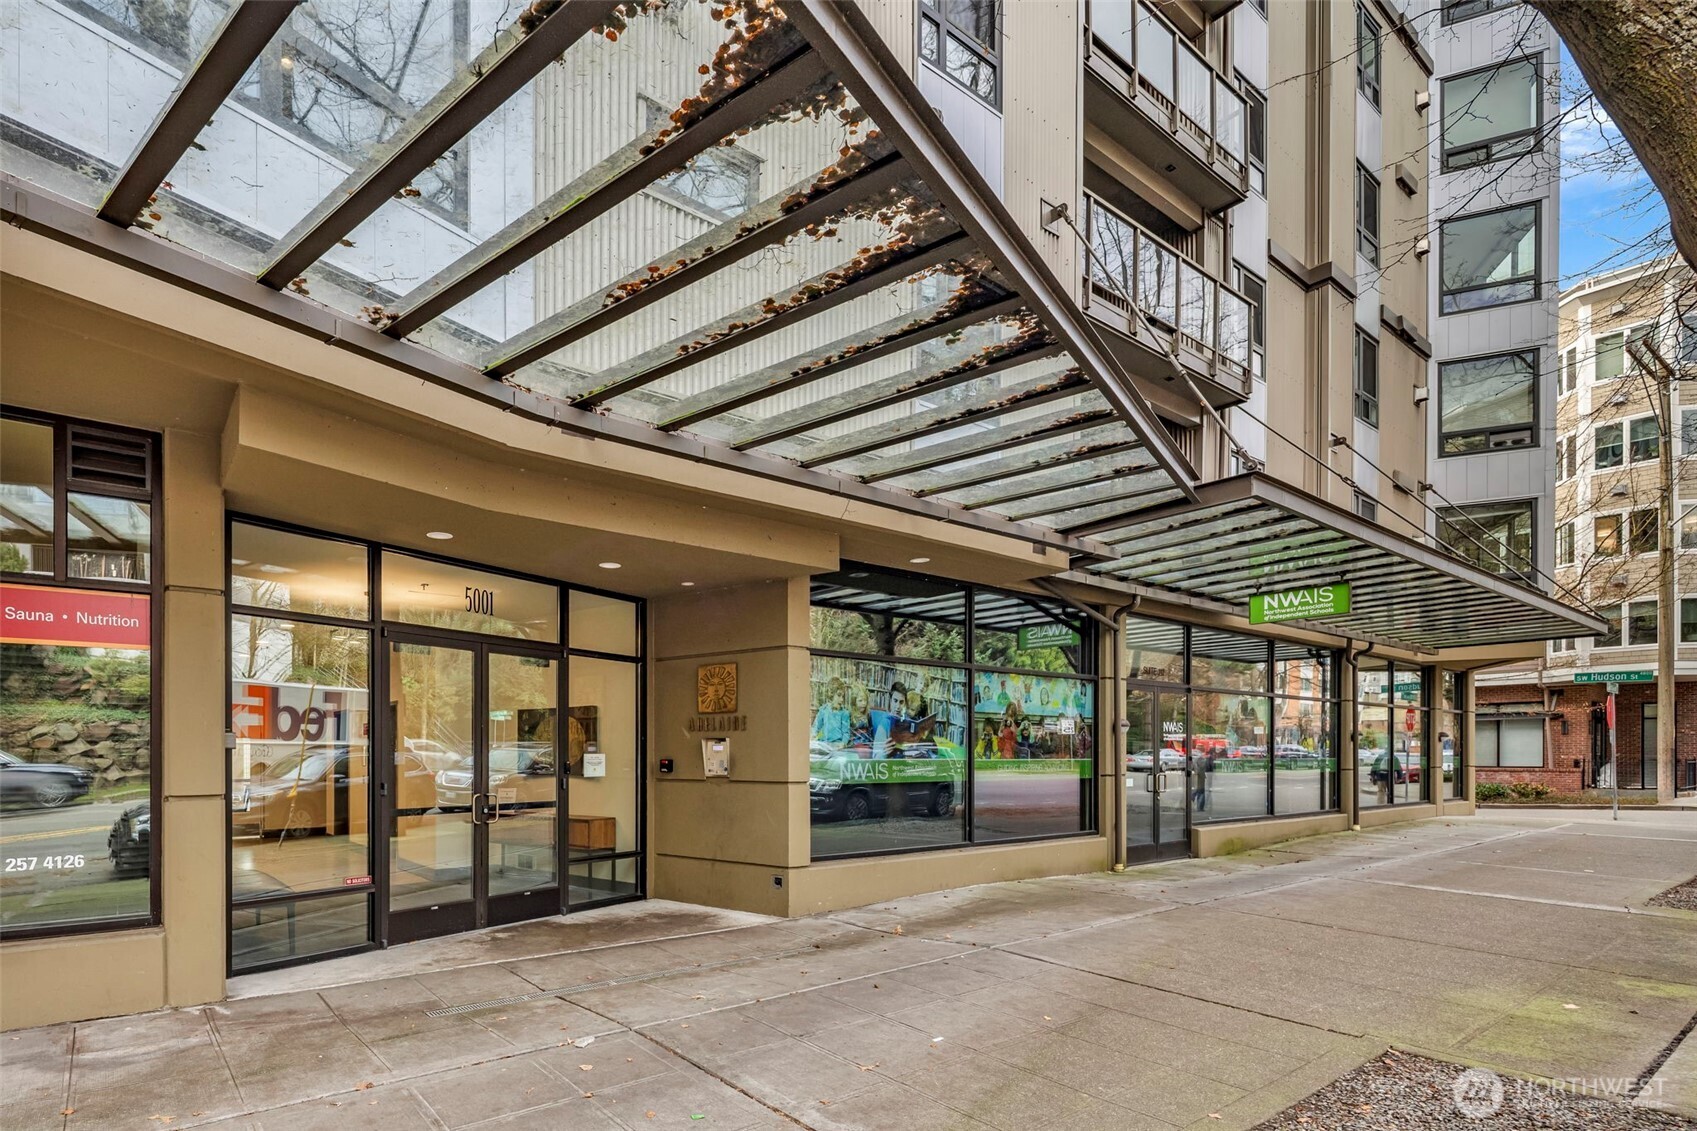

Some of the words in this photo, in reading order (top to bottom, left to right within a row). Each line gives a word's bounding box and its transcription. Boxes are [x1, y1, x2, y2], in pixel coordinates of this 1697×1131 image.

[465, 586, 494, 617] 5001
[1263, 586, 1334, 610] NWAIS
[4, 606, 54, 622] Sauna
[76, 611, 140, 628] Nutrition
[1263, 606, 1297, 616] Northwest
[1297, 602, 1334, 611] Association
[1269, 611, 1309, 620] Independent
[1309, 607, 1335, 615] Schools
[1590, 673, 1627, 681] Hudson
[1163, 721, 1184, 733] NWAIS
[840, 762, 889, 780] NWAIS
[5, 856, 38, 872] 257
[43, 854, 85, 869] 4126
